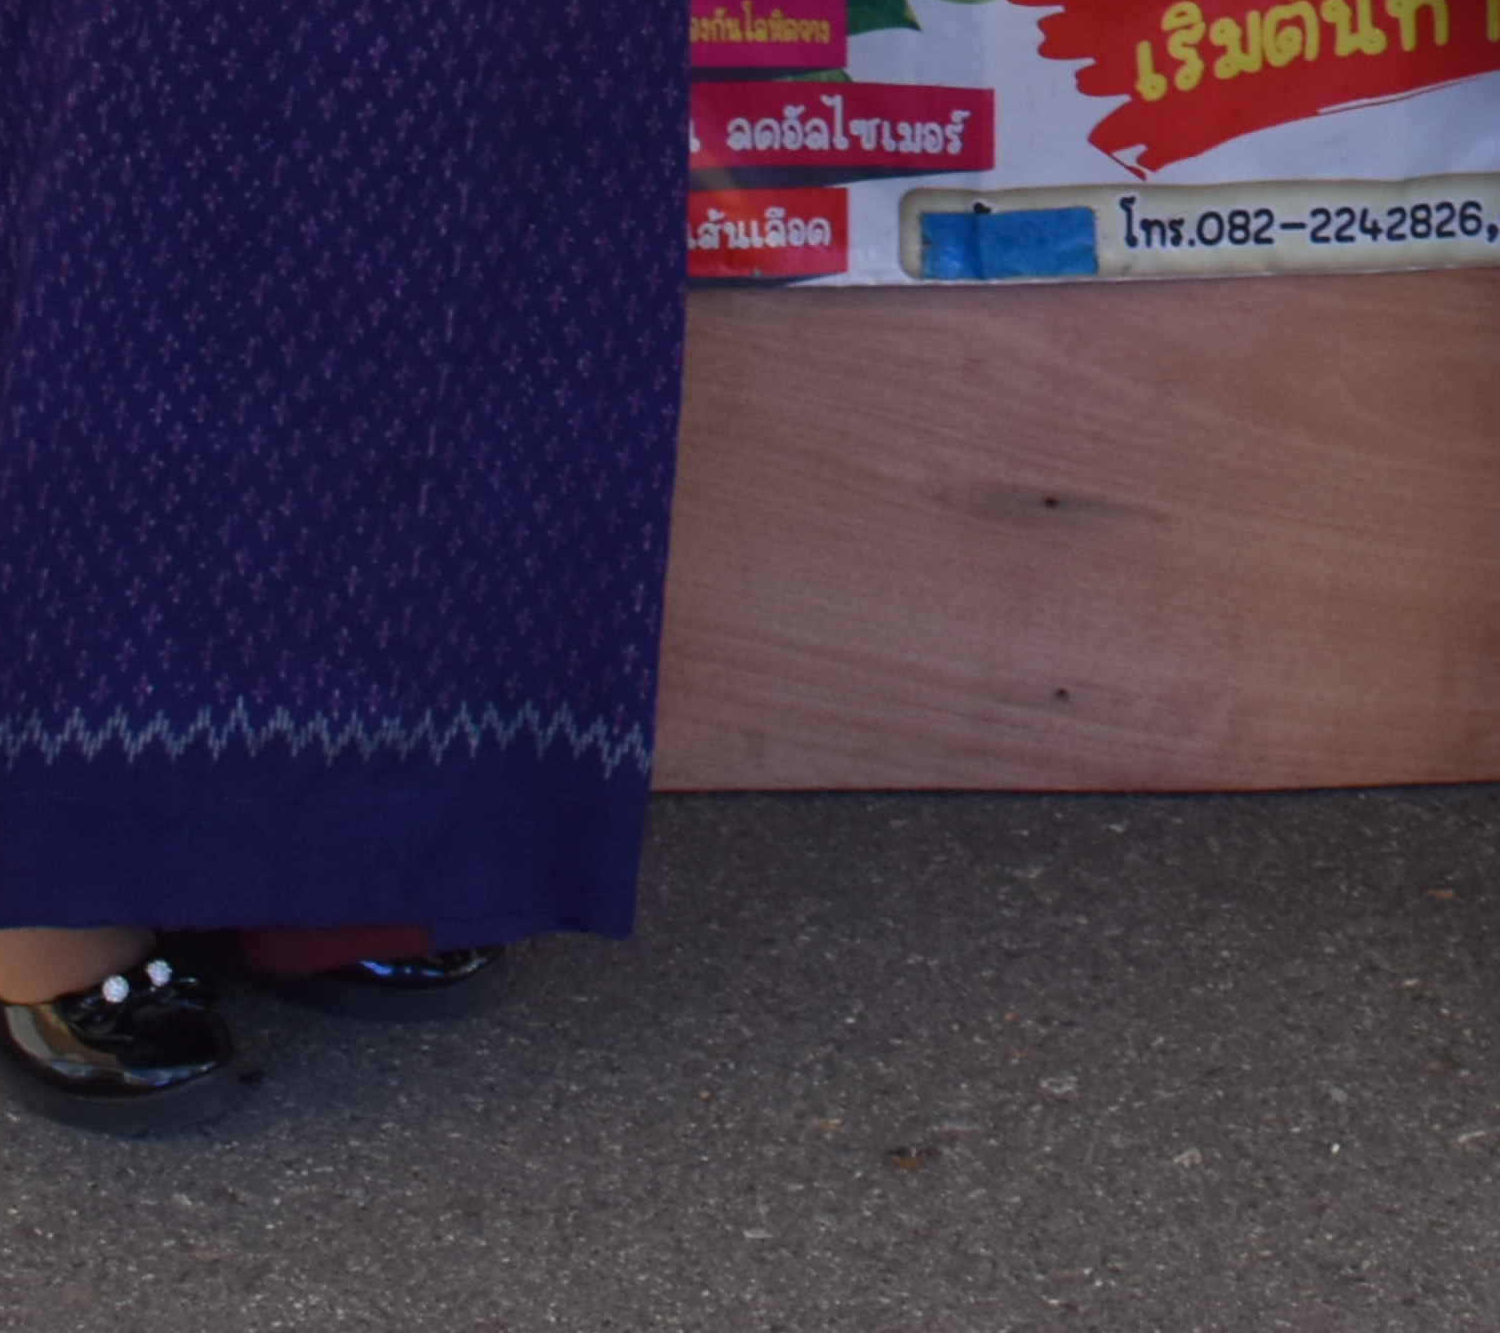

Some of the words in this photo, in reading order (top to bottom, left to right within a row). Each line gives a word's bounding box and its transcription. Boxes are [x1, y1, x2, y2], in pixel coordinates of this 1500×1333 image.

[690, 0, 830, 44] องกันโลหิตจาง
[727, 94, 971, 156] ลดอัลไซเมอร์
